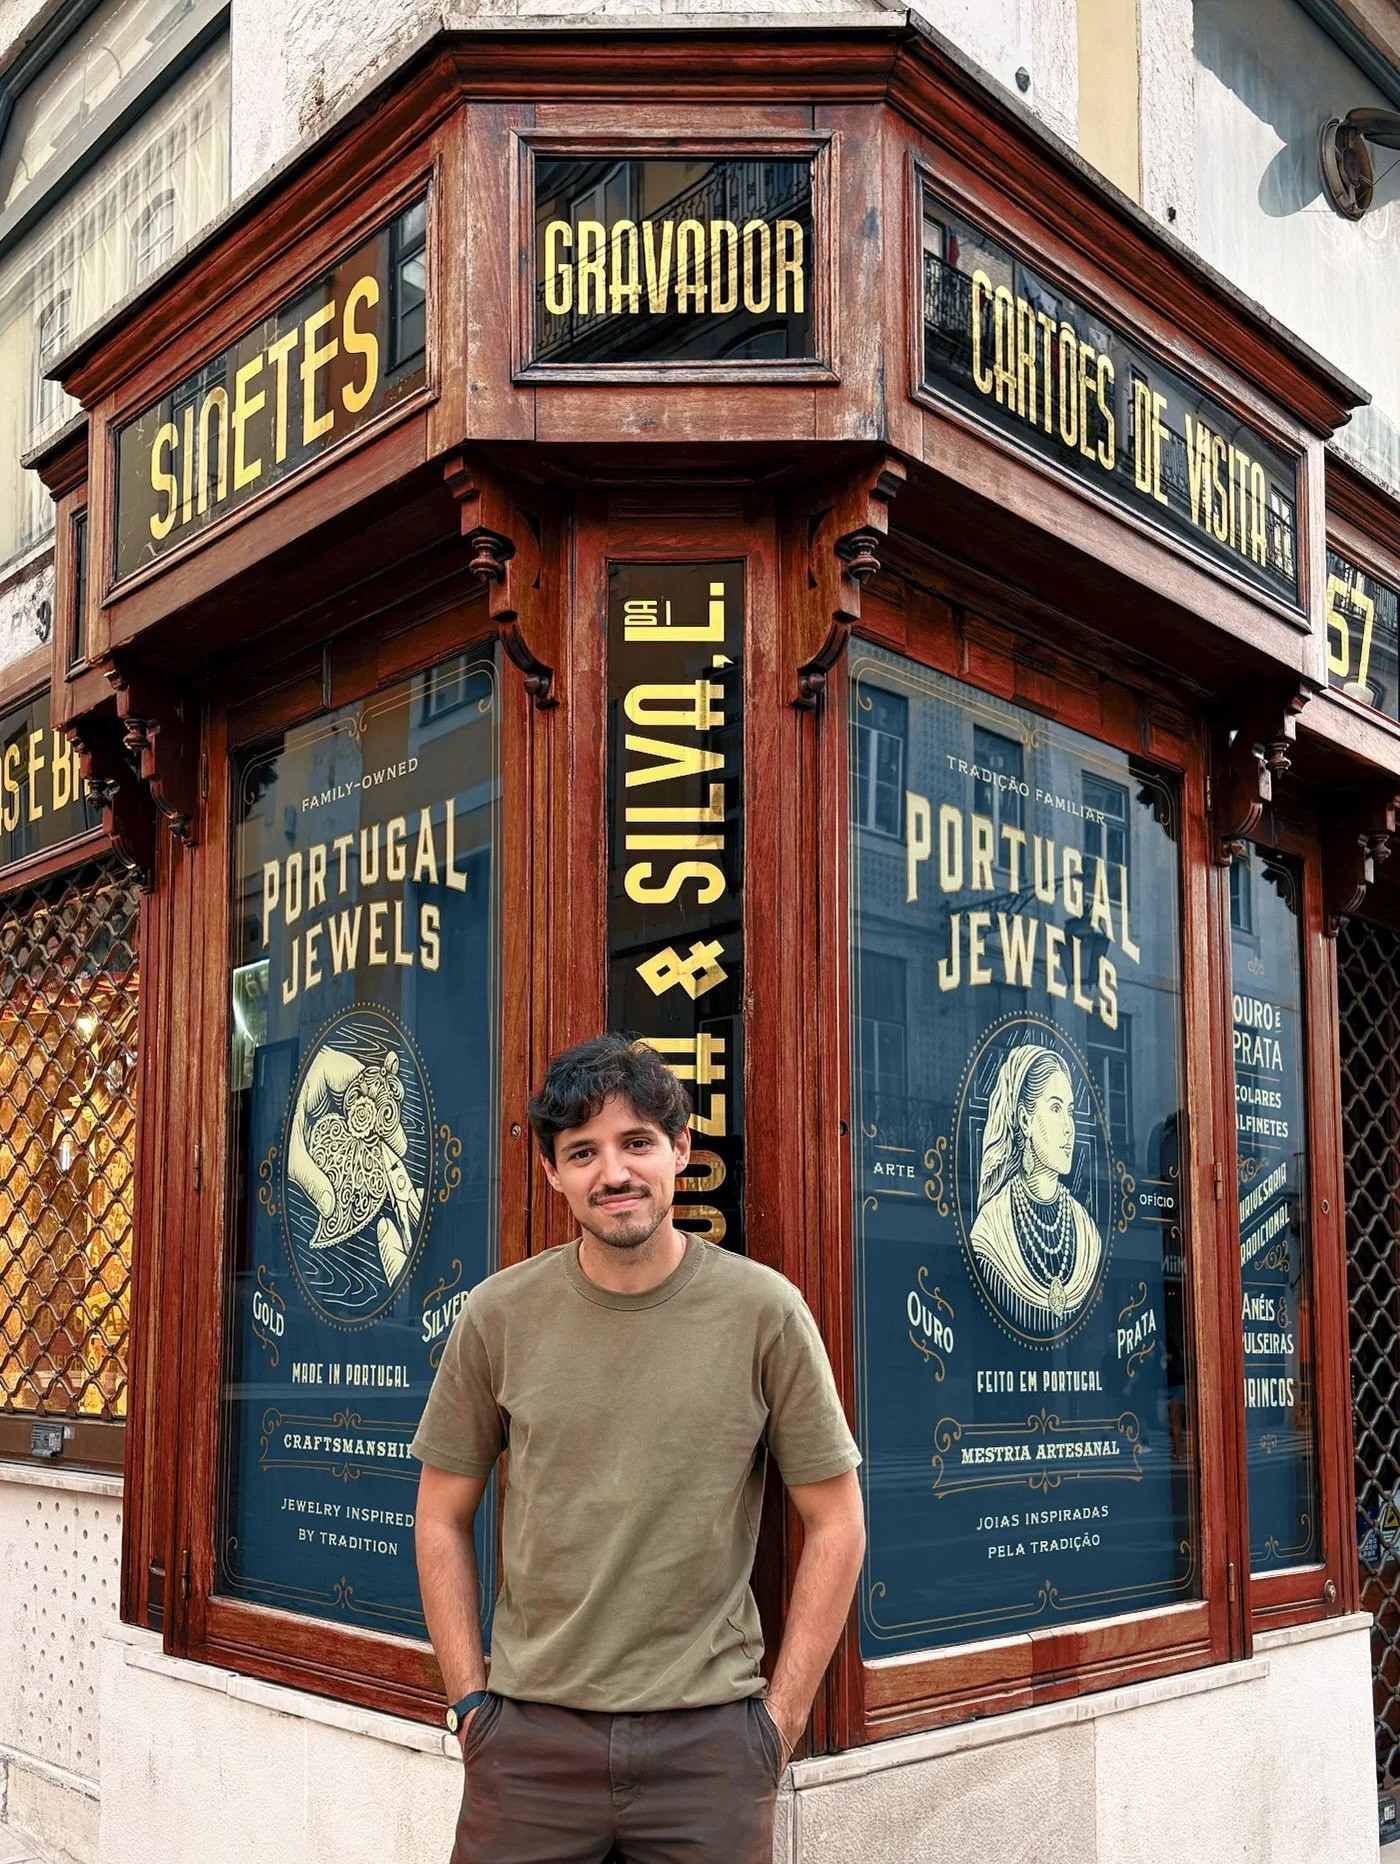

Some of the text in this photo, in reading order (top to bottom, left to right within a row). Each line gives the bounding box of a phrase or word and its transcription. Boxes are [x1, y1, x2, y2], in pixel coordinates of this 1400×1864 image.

[544, 218, 805, 315] GRAVADOR
[150, 275, 380, 540] SINETES
[1132, 377, 1169, 507] DE
[1184, 412, 1267, 568] VISITA
[1327, 572, 1375, 690] 57
[301, 757, 419, 812] FAMILY-OWNED
[946, 754, 1106, 825] TRADIÇÃO FAMILIAR
[261, 797, 468, 949] PORTUGAL
[905, 790, 1141, 966] PORTUGAL
[281, 899, 441, 1006] JEWELS
[635, 940, 729, 1001] &
[937, 911, 1119, 1031] JEWELS
[1233, 994, 1282, 1031] OURO E
[1233, 1030, 1283, 1072] PRATA
[1235, 1084, 1282, 1109] COLARES
[872, 1161, 916, 1178] ARTE
[1139, 1191, 1175, 1209] OFÍCIO
[252, 1290, 285, 1337] GOLD
[907, 1290, 954, 1354] OURO
[1241, 1292, 1276, 1321] ANÉIS
[1116, 1308, 1157, 1359] PRATA
[1242, 1332, 1295, 1355] ULSEIRAS
[292, 1363, 410, 1388] MADE IN PORTUGAL
[977, 1370, 1103, 1393] FEITO EM PORTUGAL
[961, 1440, 1120, 1465] MESTRIA ARTESANAL
[280, 1497, 415, 1528] JEWELRY INSPIRED
[976, 1505, 1109, 1530] JOIAS INSPIRADAS
[298, 1528, 398, 1556] BY TRADITION
[988, 1532, 1100, 1559] PELA TRADIÇÃO
